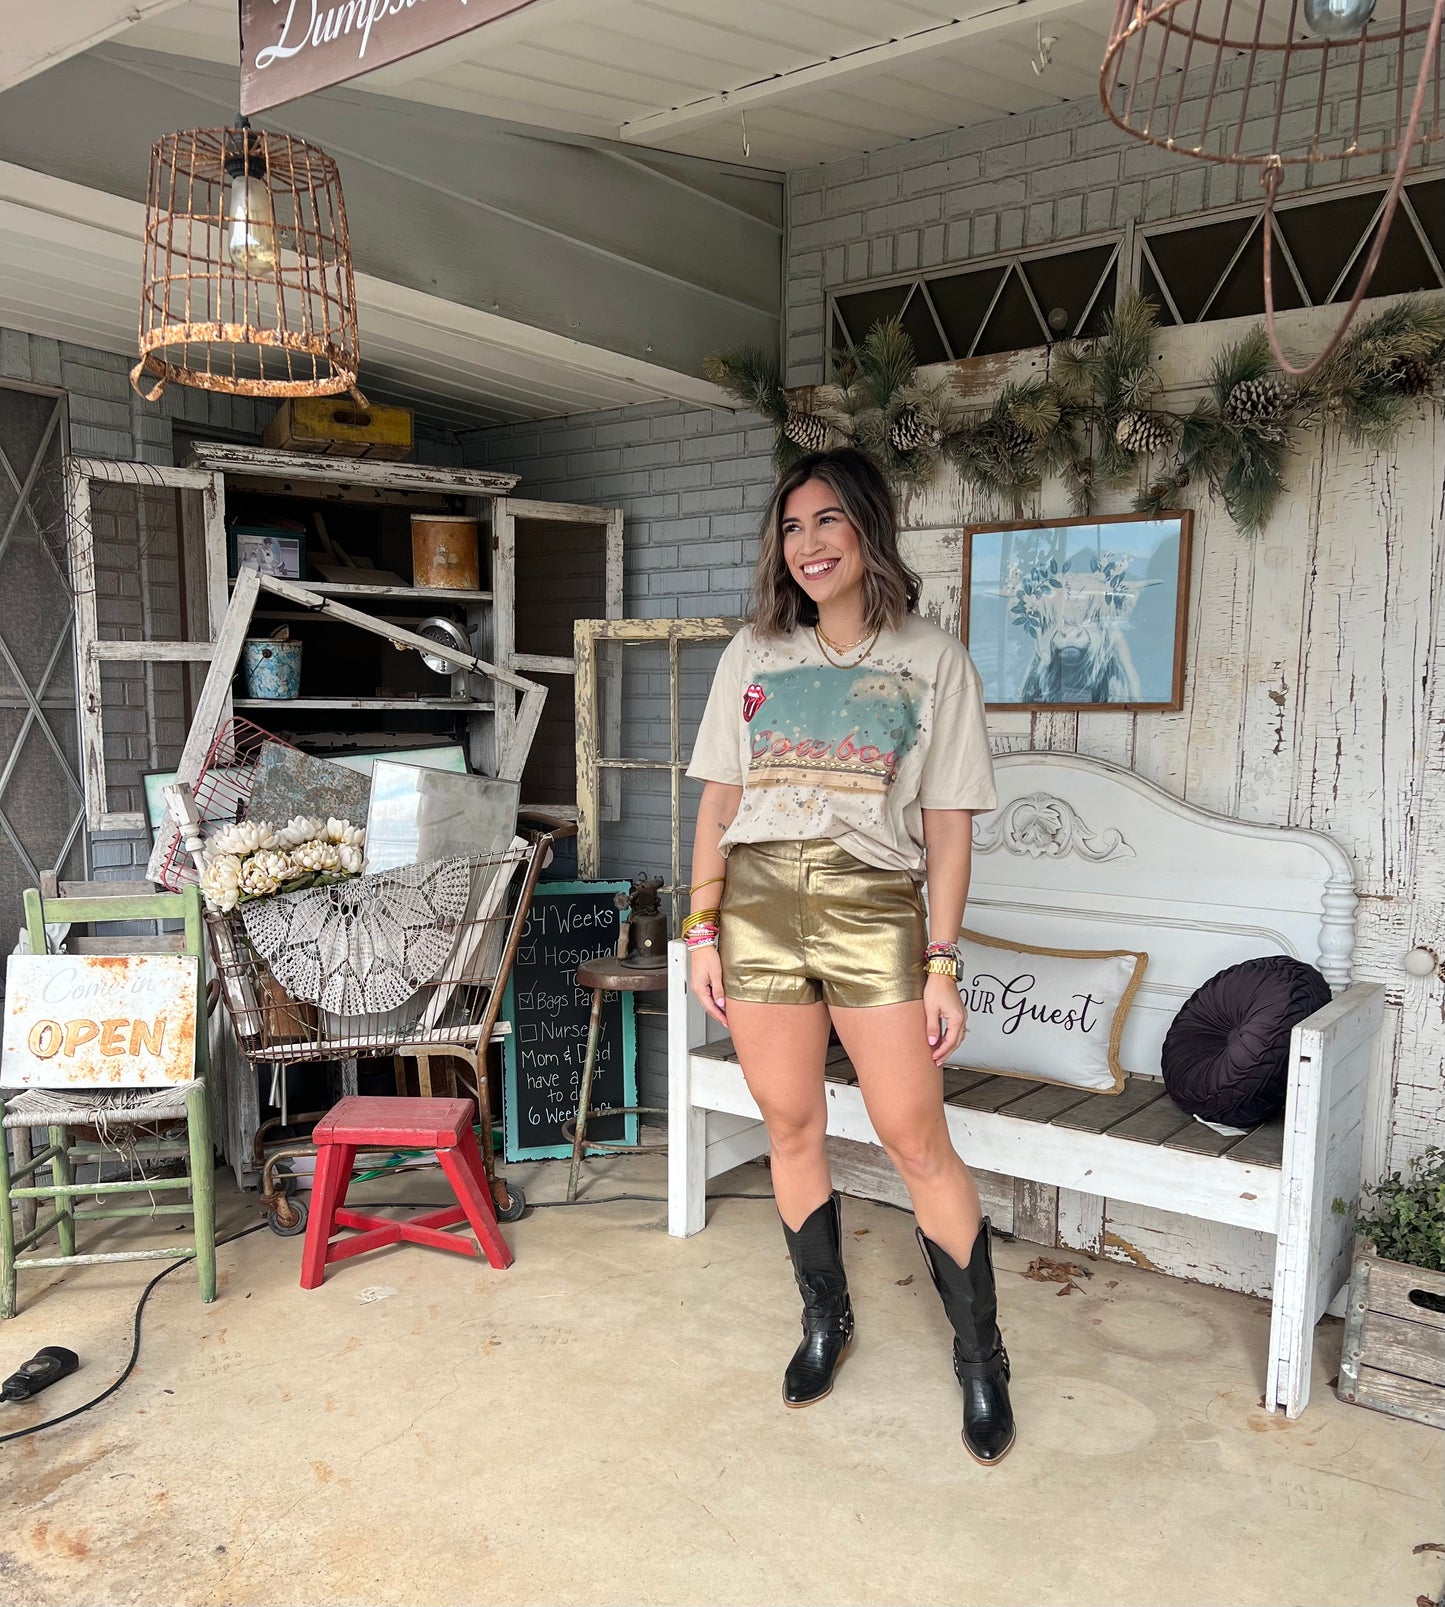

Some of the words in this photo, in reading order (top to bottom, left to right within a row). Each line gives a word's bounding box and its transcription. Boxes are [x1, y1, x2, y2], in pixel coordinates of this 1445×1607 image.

[549, 903, 614, 934] Weeks
[544, 941, 618, 967] Hospital
[42, 967, 121, 1004] Come
[130, 975, 156, 994] in
[537, 992, 569, 1017] Bags
[972, 974, 1105, 1035] Guest
[28, 1019, 166, 1059] OPEN
[541, 1021, 607, 1042] Nursey
[521, 1050, 559, 1068] Mom
[563, 1045, 572, 1065] &
[526, 1073, 560, 1089] have
[547, 1089, 564, 1103] to
[528, 1106, 541, 1125] 6
[545, 1105, 579, 1124] Week
